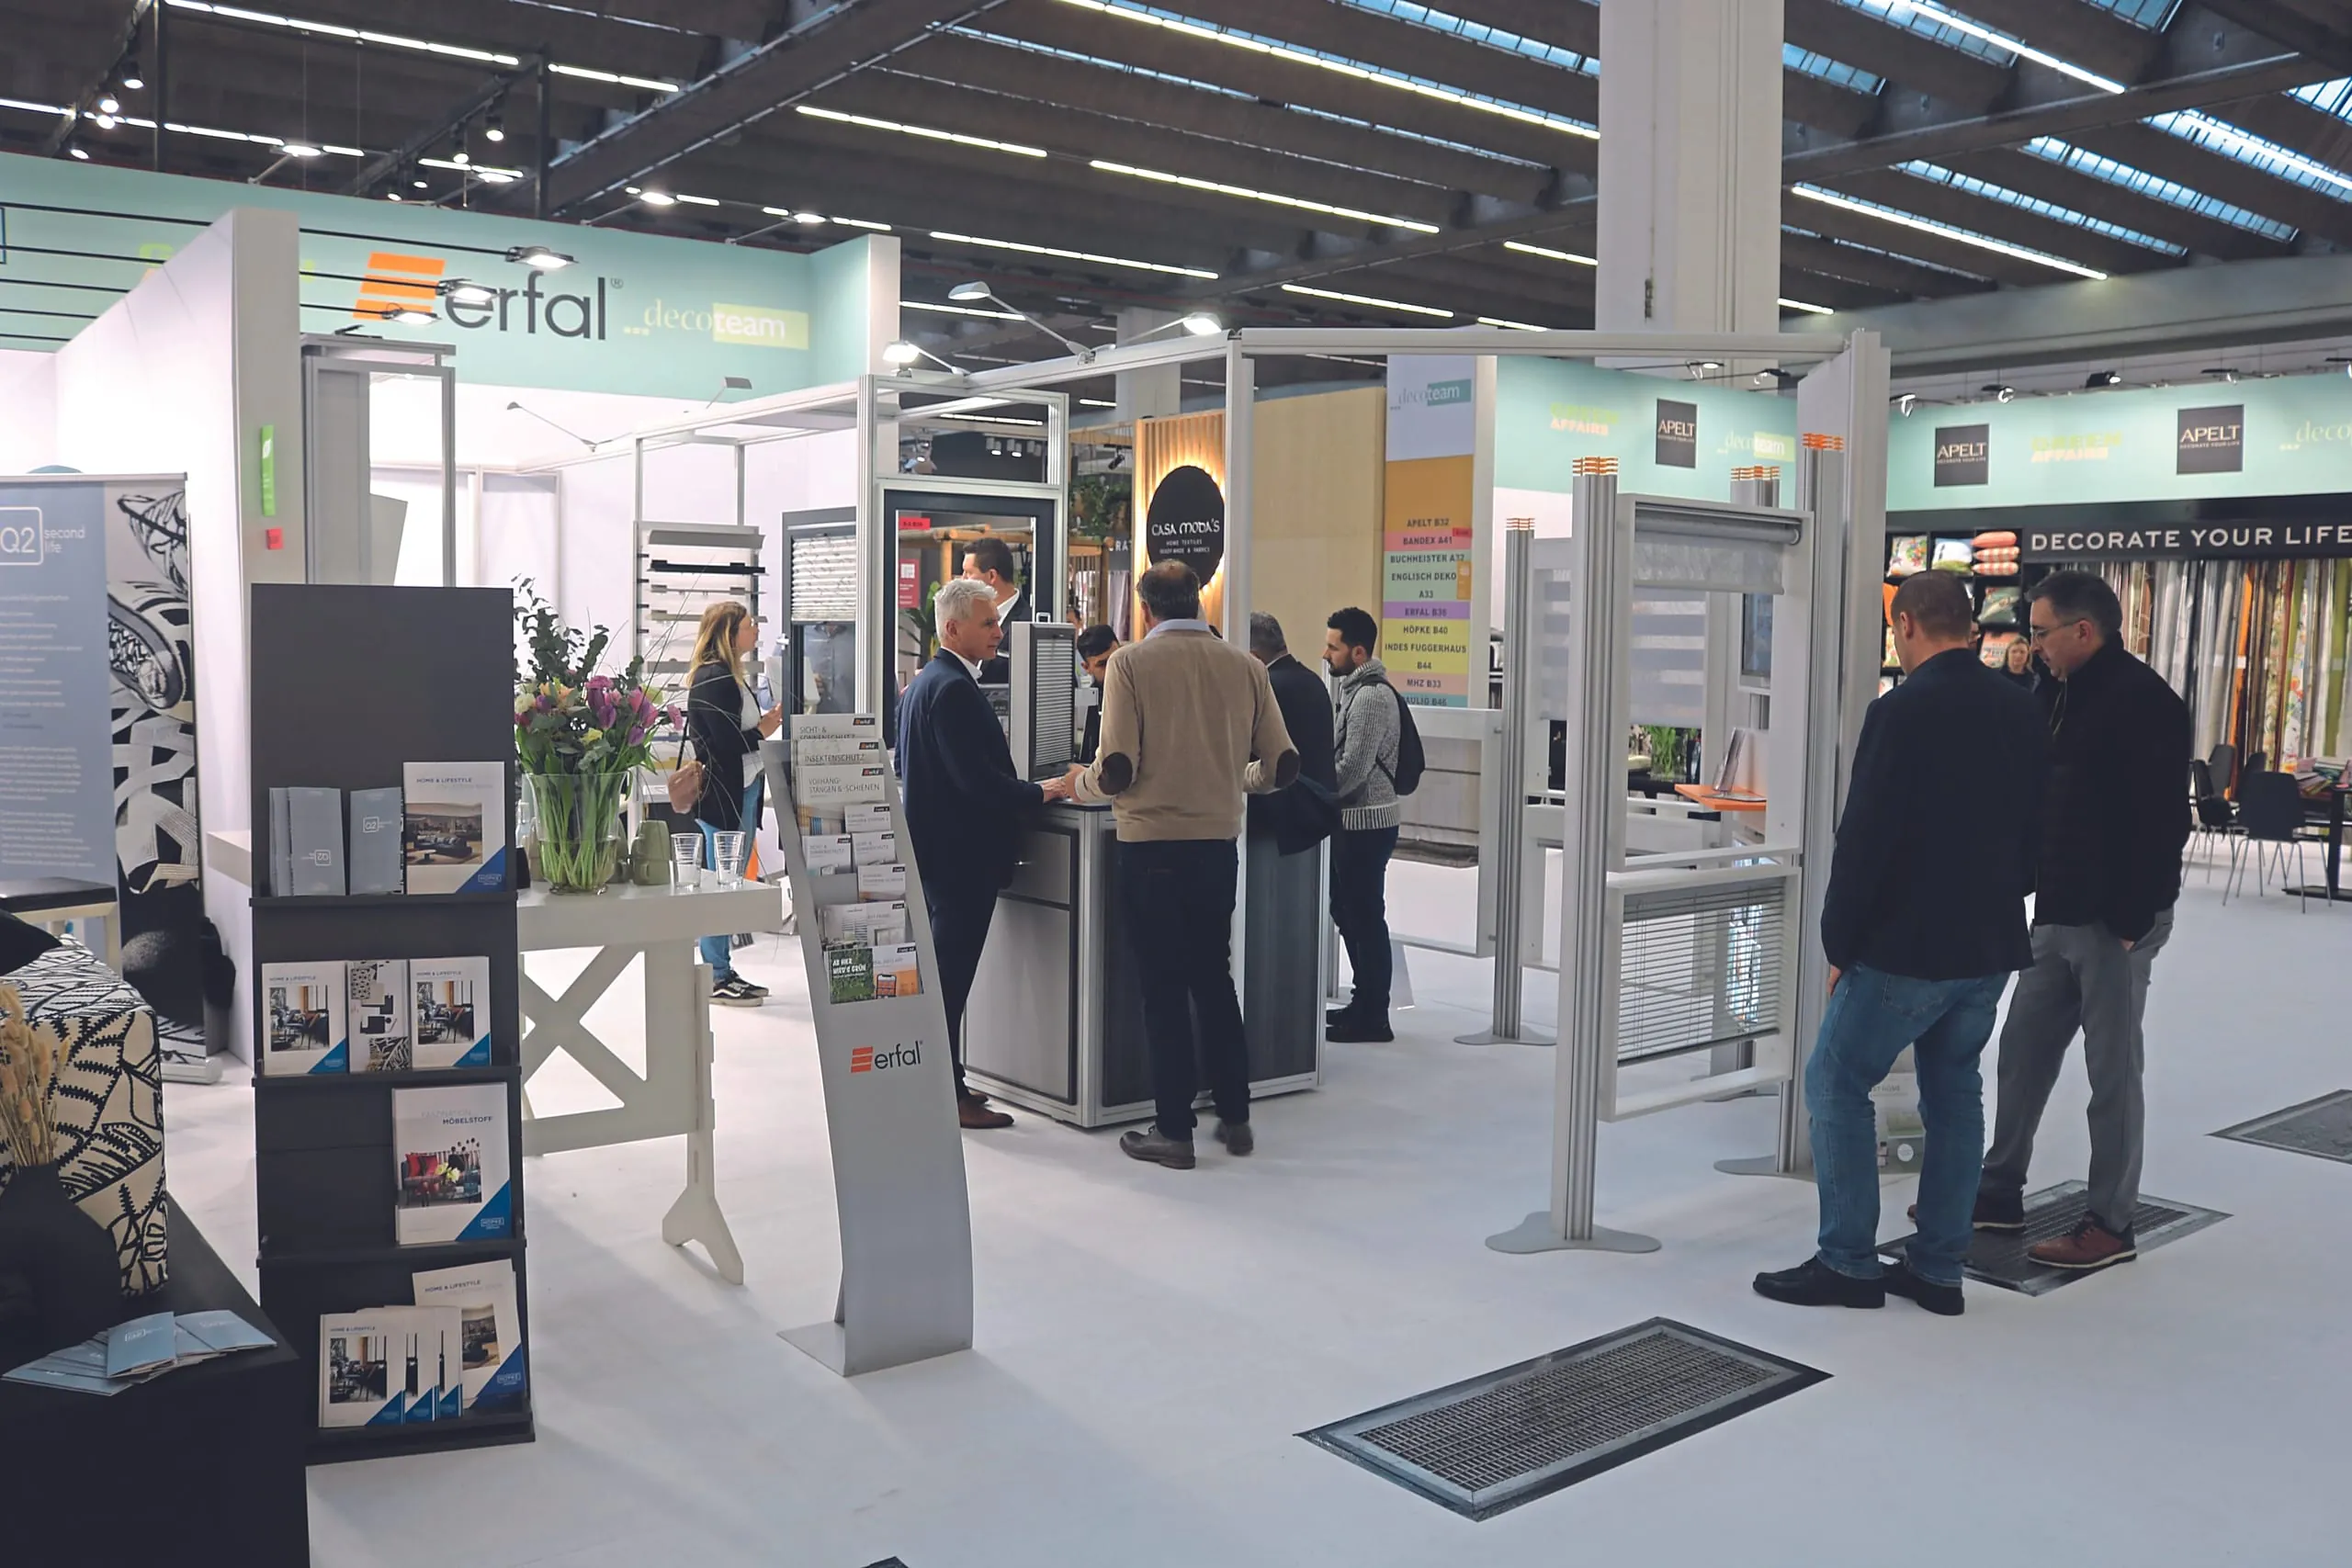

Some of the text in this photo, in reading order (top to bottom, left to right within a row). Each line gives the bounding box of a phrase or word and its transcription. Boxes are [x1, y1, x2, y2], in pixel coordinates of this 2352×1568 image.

[1657, 420, 1695, 437] APELT
[2180, 424, 2241, 443] APELT
[1937, 442, 1987, 457] APELT
[1407, 518, 1432, 528] APELT
[44, 525, 85, 539] second
[1151, 523, 1177, 536] CASA
[0, 527, 36, 553] Q2
[1403, 536, 1435, 546] BANDEX
[2031, 525, 2352, 551] DECORATE YOUR LIFE
[44, 540, 62, 554] life
[1391, 572, 1456, 581] ENGLISCH DEKO
[1419, 590, 1433, 599] A33
[1405, 607, 1430, 616] ERFAL
[1433, 626, 1448, 634] B40
[1410, 644, 1467, 653] FUGGERHAUS
[1417, 661, 1431, 670] B44
[1407, 679, 1424, 687] MHZ
[1406, 696, 1430, 705] AULIG
[805, 753, 865, 762] INSEKTENSCHUTZ
[809, 785, 837, 794] STANGEN
[443, 1116, 493, 1124] MÖBELSTOFF
